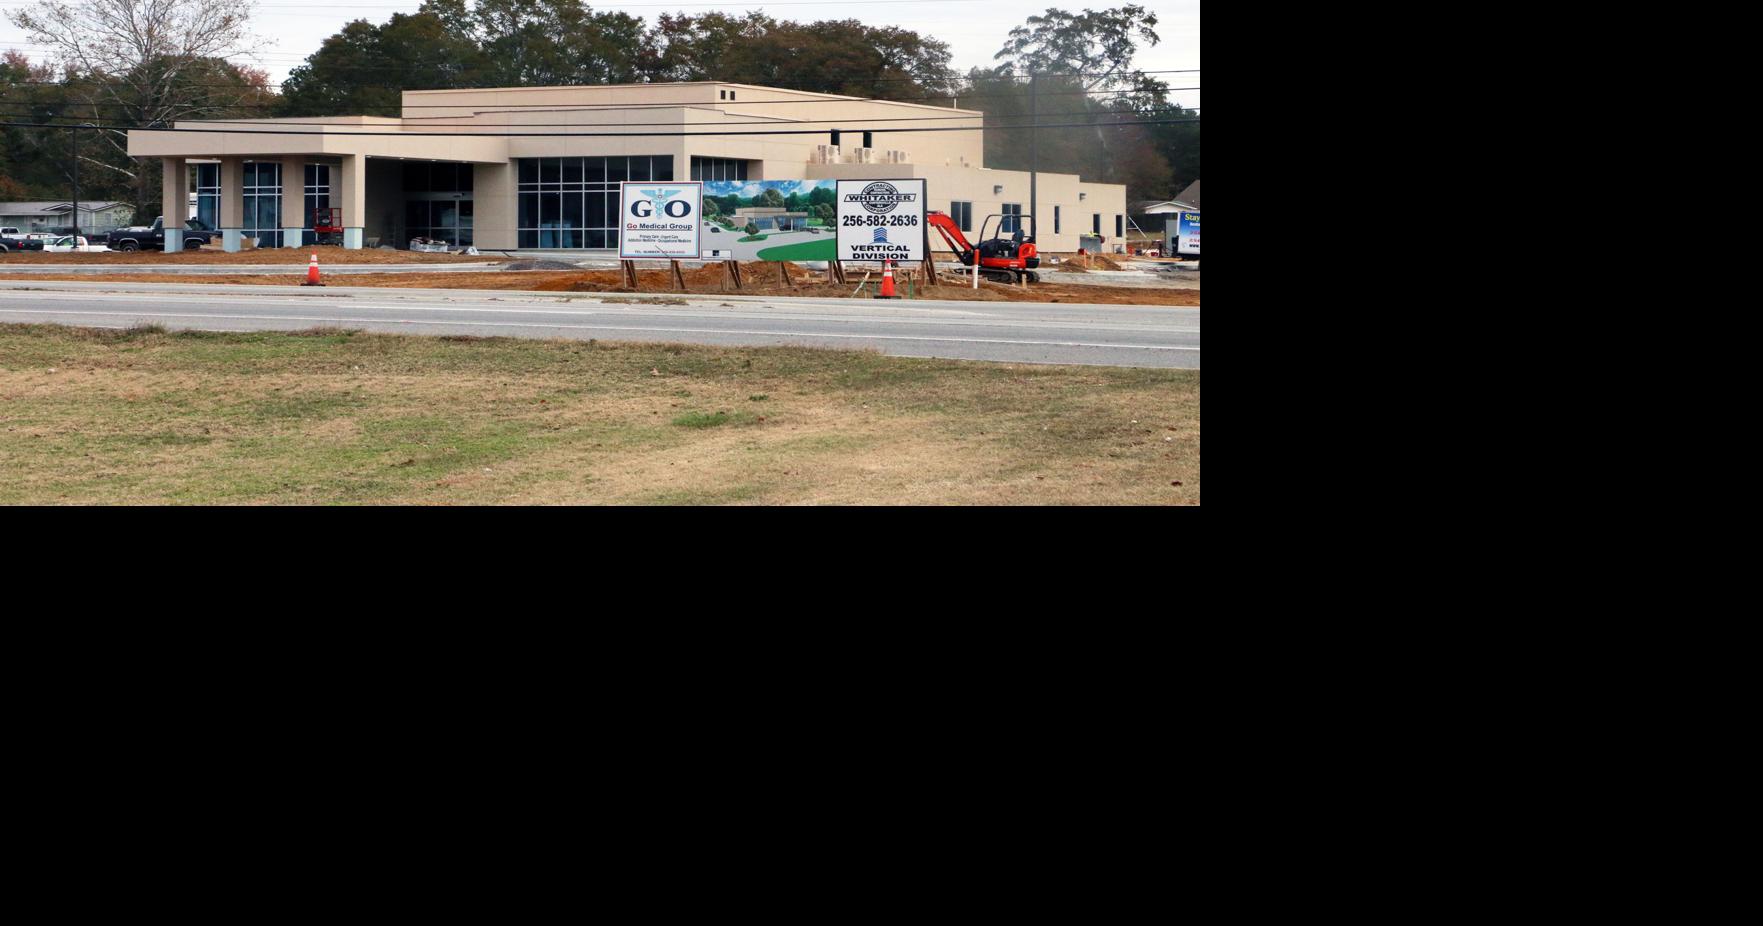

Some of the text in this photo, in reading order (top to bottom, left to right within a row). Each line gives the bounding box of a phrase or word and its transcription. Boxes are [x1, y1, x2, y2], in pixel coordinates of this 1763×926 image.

[863, 183, 896, 194] CONTRACTING
[864, 203, 896, 213] CORPORATION
[843, 215, 917, 226] 256-582-2636
